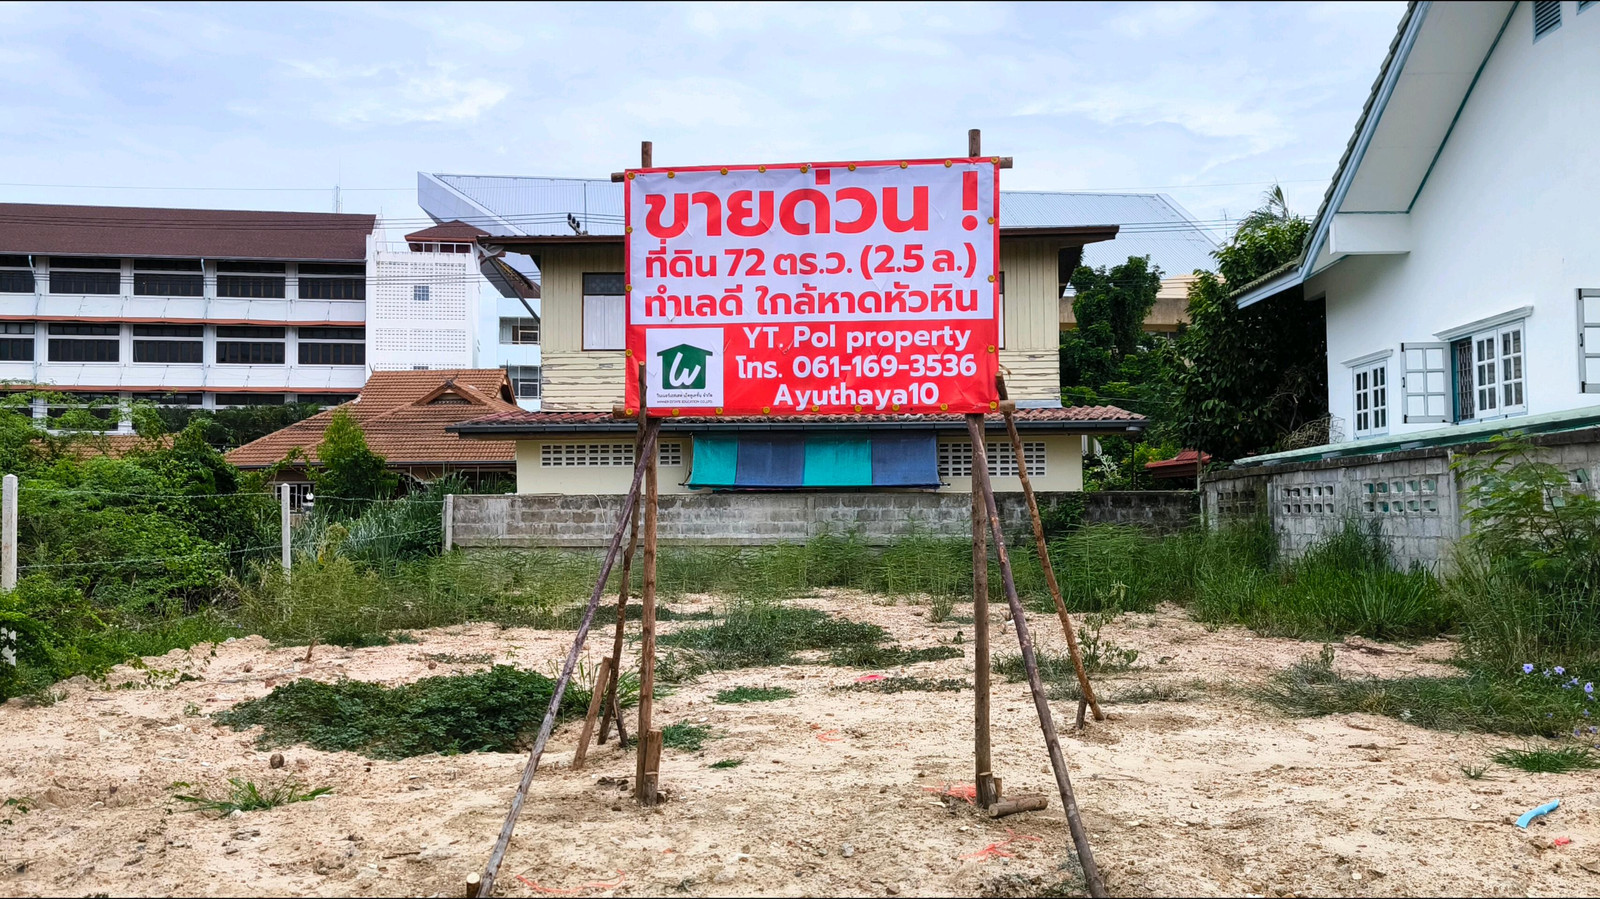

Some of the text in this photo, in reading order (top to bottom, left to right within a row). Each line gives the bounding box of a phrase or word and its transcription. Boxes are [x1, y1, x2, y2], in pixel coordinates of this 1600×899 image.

[645, 169, 978, 239] ขายด่วน !
[646, 239, 976, 280] ที่ดิน 72 ตร.ว. (2.5 ล.)
[645, 282, 977, 317] ทำเลดี ใกล้หาดหัวหิน
[743, 325, 971, 353] YT. Pol property
[736, 354, 976, 378] โทร. 061-169-3536
[773, 382, 939, 410] Ayuthaya10
